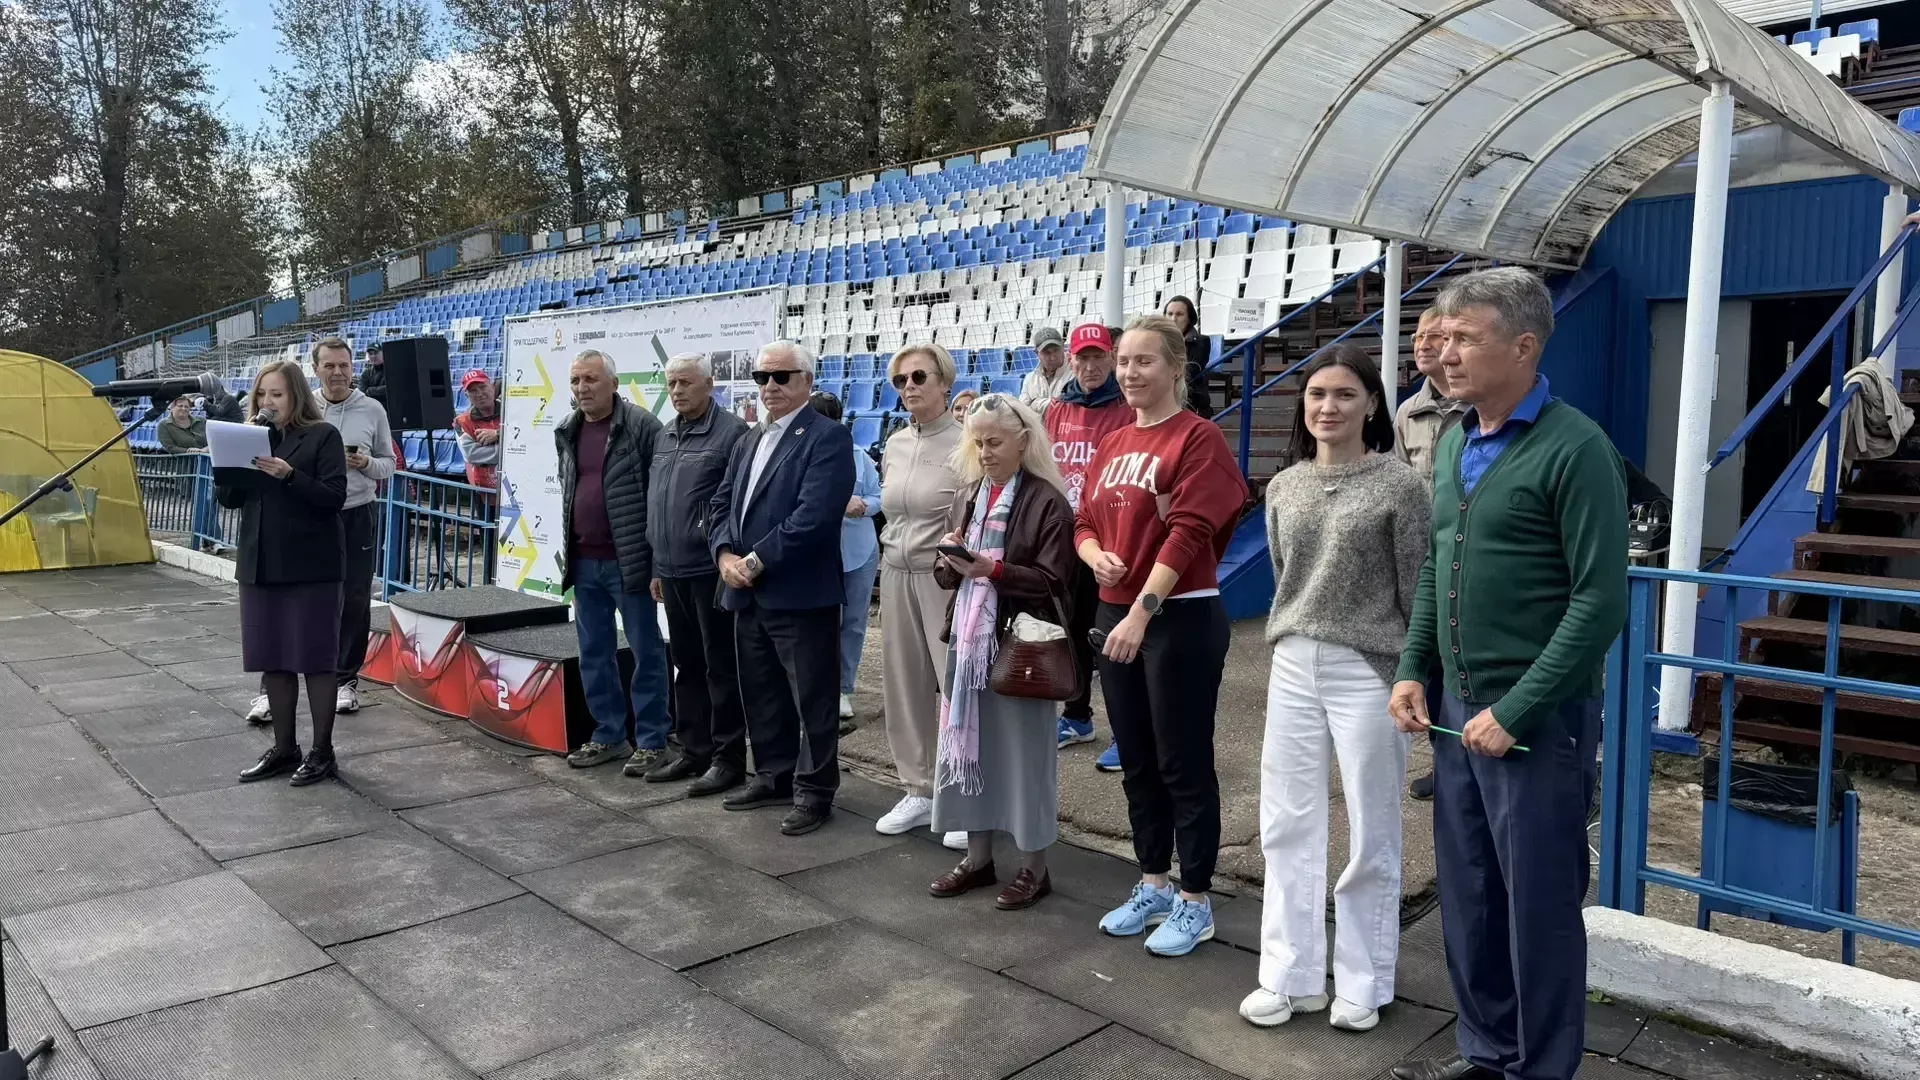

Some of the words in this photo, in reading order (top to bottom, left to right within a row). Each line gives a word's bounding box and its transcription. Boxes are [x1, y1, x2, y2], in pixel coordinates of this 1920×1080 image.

[1080, 326, 1101, 340] ГТО
[1051, 441, 1097, 466] СУДЬ
[1091, 452, 1161, 501] PUMA
[415, 641, 422, 673] 1
[497, 678, 510, 711] 2
